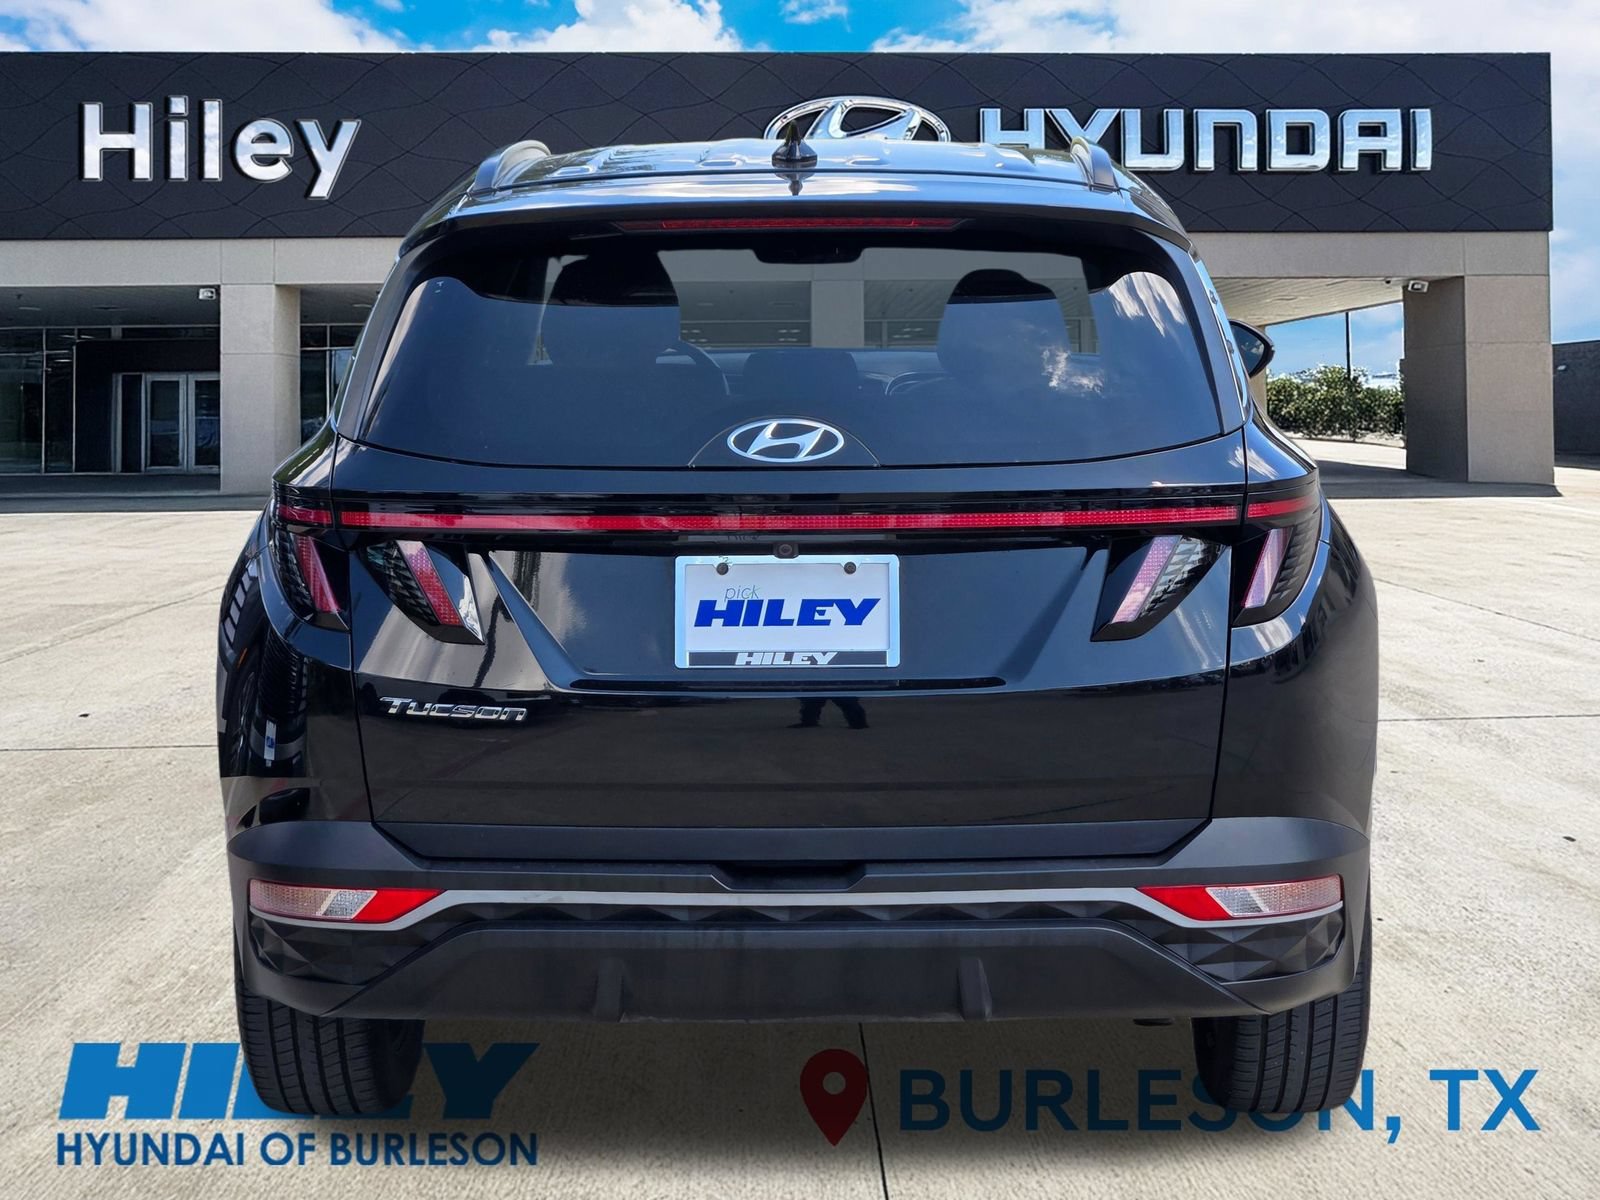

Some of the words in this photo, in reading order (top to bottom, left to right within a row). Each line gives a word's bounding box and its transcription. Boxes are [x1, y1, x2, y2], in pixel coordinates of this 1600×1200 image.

[80, 95, 361, 200] Hiley
[979, 108, 1432, 171] HYUNDAI
[724, 585, 760, 601] pick
[694, 598, 881, 627] HILEY
[735, 652, 838, 665] HILEY
